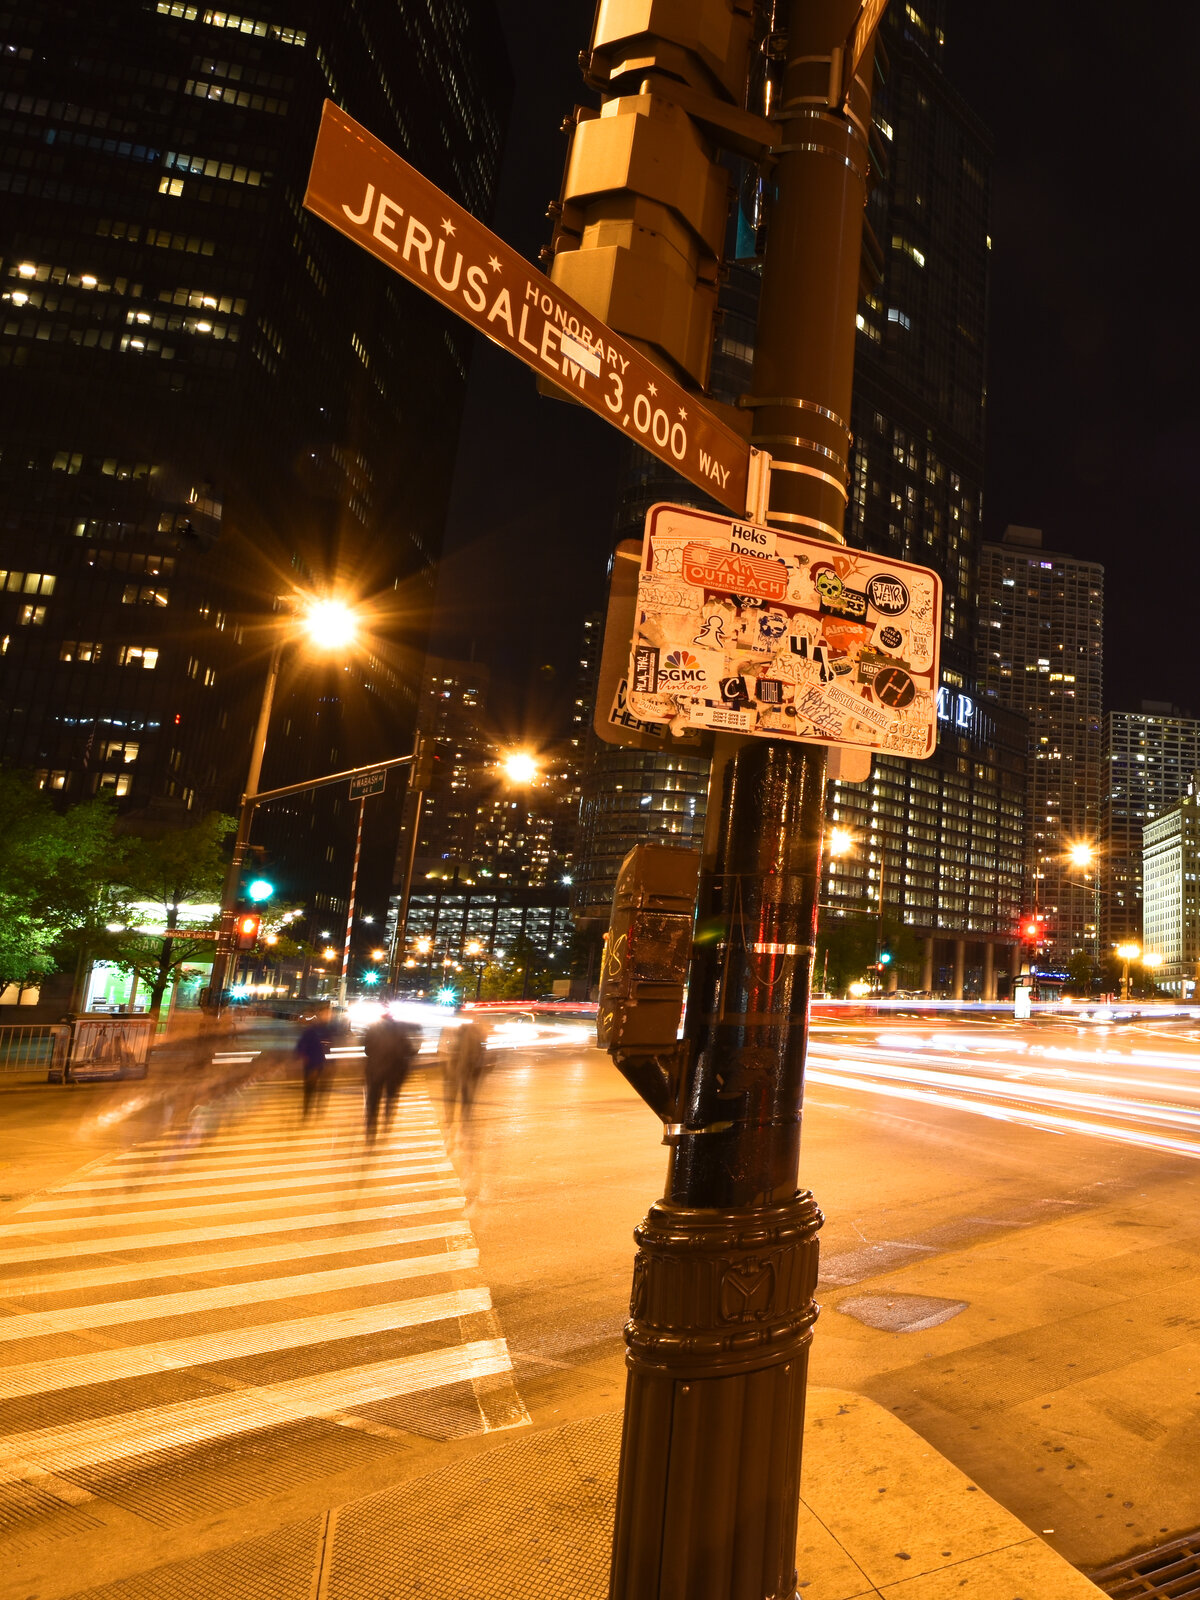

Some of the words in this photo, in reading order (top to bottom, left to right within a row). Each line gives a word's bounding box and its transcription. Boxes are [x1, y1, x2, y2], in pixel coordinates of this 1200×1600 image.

[341, 182, 587, 390] JERUSALEM
[604, 372, 687, 460] 3,000
[699, 448, 731, 490] WAY
[525, 281, 630, 375] HONORARY
[732, 525, 767, 545] Heks
[690, 567, 780, 594] OUTREACH
[825, 624, 864, 636] Almost
[658, 669, 707, 682] SGMC
[657, 679, 709, 695] Vintage
